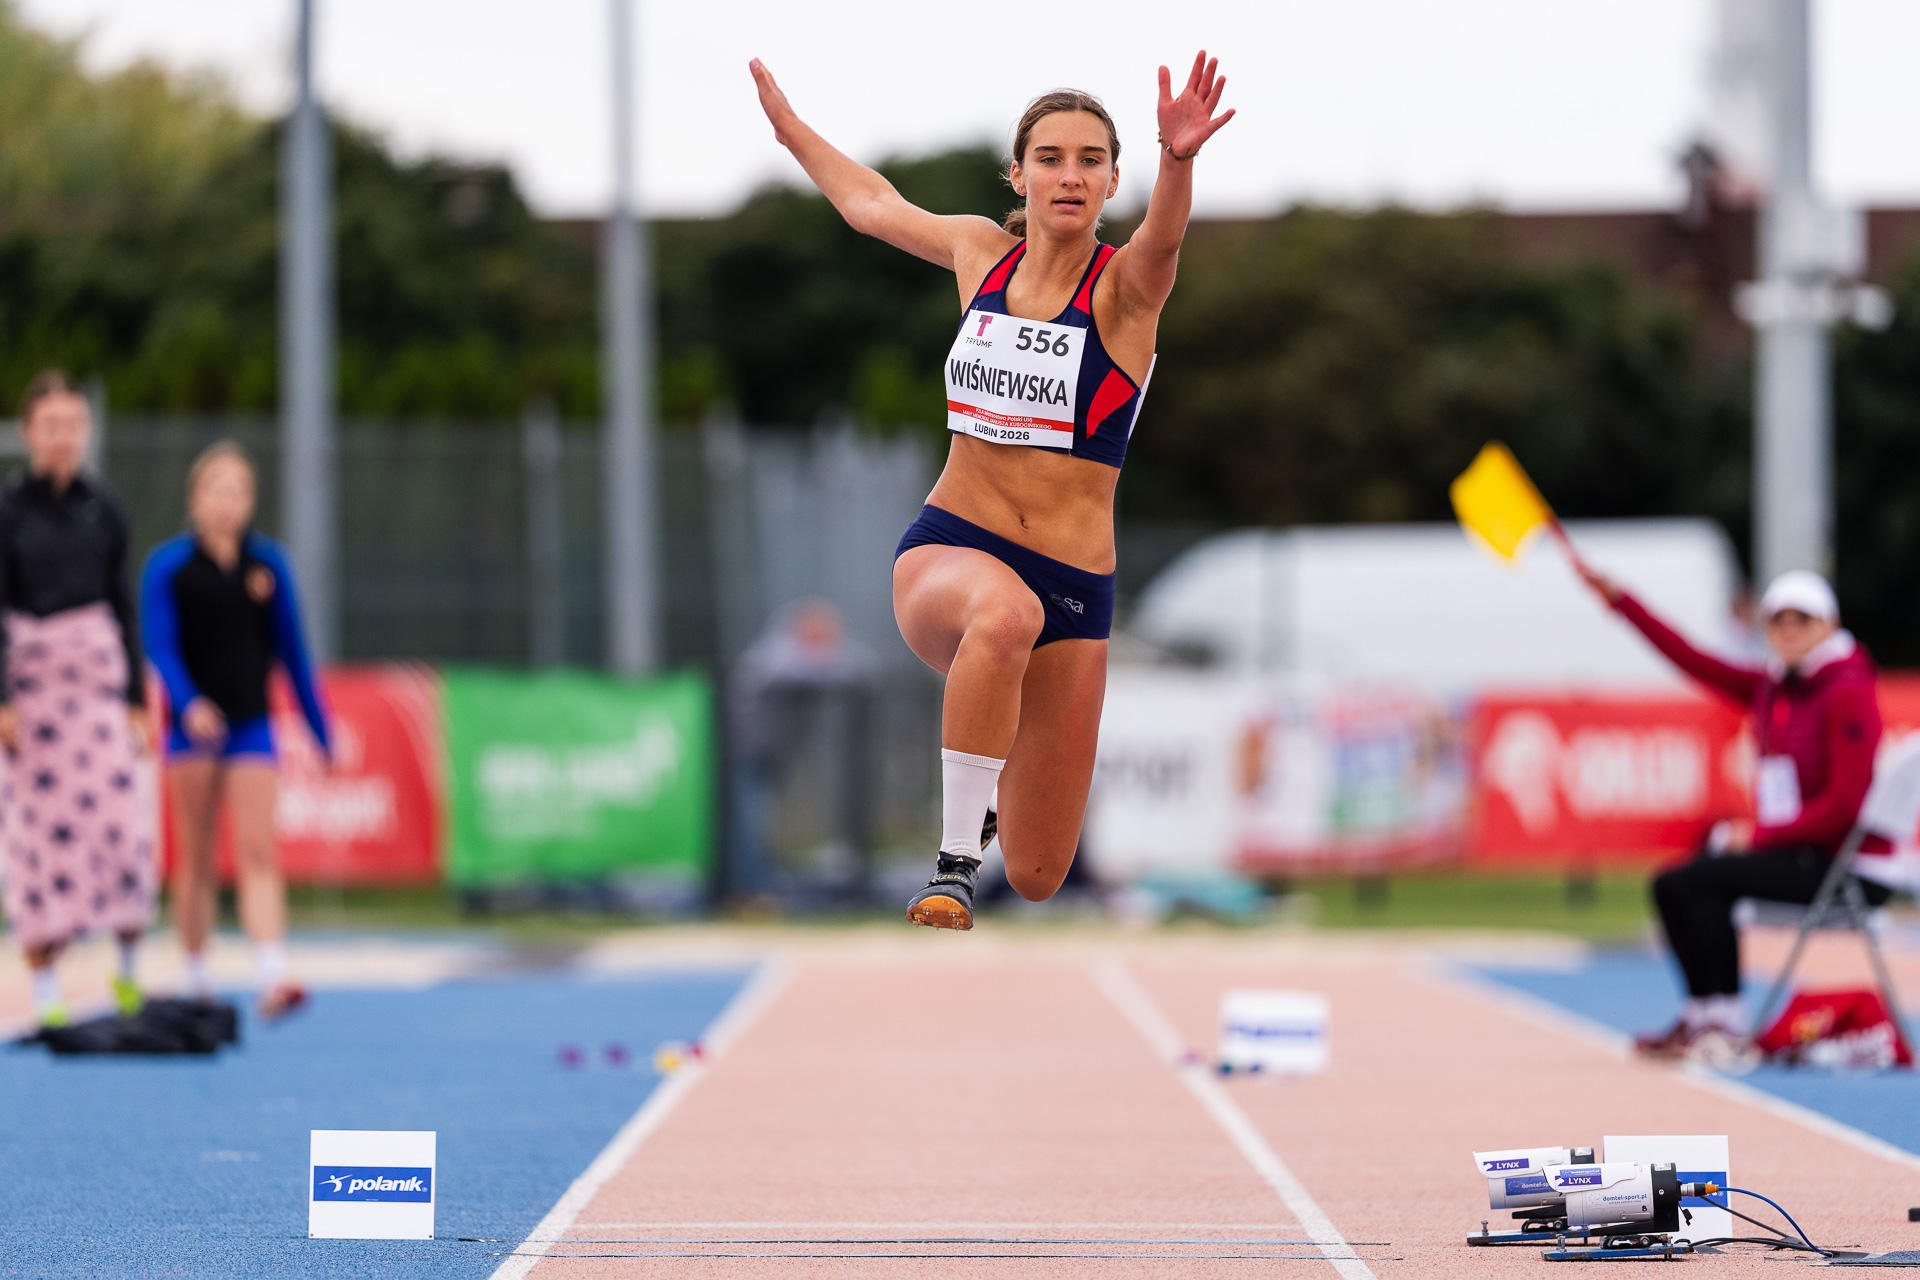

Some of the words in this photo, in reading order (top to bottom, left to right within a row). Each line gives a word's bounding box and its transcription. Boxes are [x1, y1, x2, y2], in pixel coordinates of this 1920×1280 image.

[965, 337, 993, 348] TRYUMF
[1015, 326, 1070, 357] 556
[950, 358, 1068, 406] WIŚNIEWSKA
[974, 422, 998, 438] LUBIN
[1000, 429, 1030, 441] 2026
[1496, 1161, 1520, 1170] LYNX
[347, 1175, 424, 1194] polanik
[1568, 1177, 1592, 1185] LYNX
[1602, 1192, 1648, 1203] domtel-sport.pl
